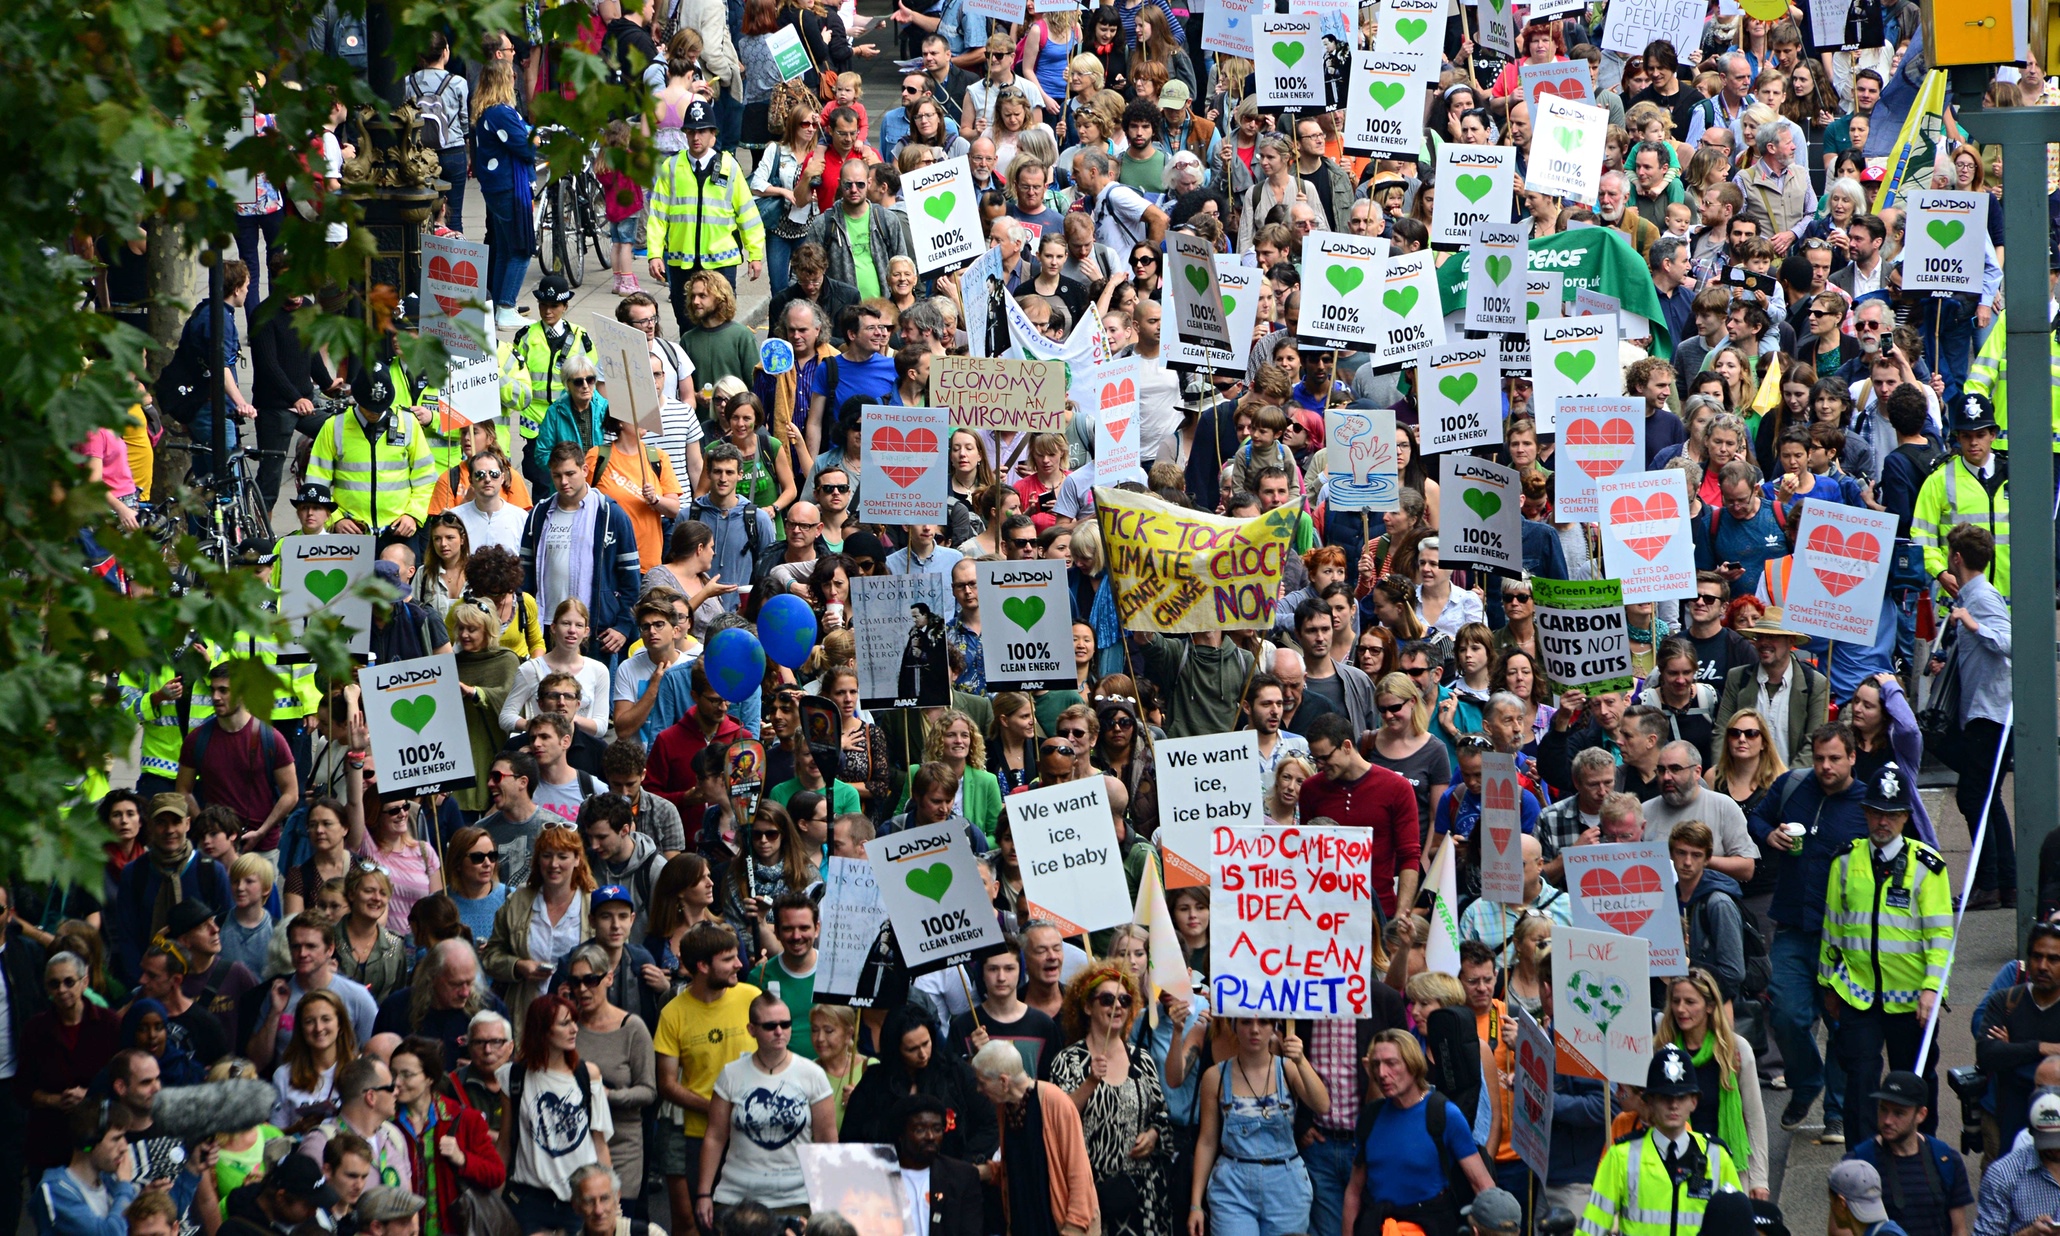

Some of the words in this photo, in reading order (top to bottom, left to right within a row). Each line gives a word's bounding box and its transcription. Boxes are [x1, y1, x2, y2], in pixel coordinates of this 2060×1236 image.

[1264, 21, 1310, 33] LONDON
[1624, 6, 1681, 32] PEEVED.
[1489, 20, 1507, 38] 100%
[1612, 23, 1657, 49] GET
[1363, 58, 1416, 72] LONDON
[1274, 76, 1307, 90] 100%
[1268, 91, 1289, 99] CLEAN
[1290, 91, 1314, 100] ENERGY
[1366, 118, 1402, 135] 100%
[1357, 134, 1379, 143] CLEAN
[1380, 135, 1408, 146] ENERGY
[1450, 150, 1503, 164] LONDON
[1548, 159, 1582, 178] 100%
[912, 167, 959, 190] LONDON
[1920, 198, 1976, 210] LONDON
[930, 227, 965, 251] 100%
[1445, 228, 1467, 236] CLEAN
[1480, 230, 1520, 244] LONDON
[450, 245, 468, 255] LOVE
[927, 249, 947, 263] CLEAN
[948, 242, 973, 256] ENERGY
[1176, 240, 1210, 257] LONDON
[1321, 240, 1376, 256] LONDON
[1925, 258, 1963, 274] 100%
[1916, 274, 1939, 283] CLEAN
[1941, 275, 1970, 284] ENERGY
[1190, 303, 1217, 322] 100%
[1322, 304, 1359, 323] 100%
[1483, 297, 1510, 313] 100%
[1187, 319, 1205, 331] CLEAN
[1205, 322, 1222, 334] ENERGY
[1312, 320, 1335, 332] CLEAN
[1336, 322, 1366, 334] ENERGY
[1476, 314, 1494, 323] CLEAN
[1495, 315, 1516, 325] ENERGY
[421, 325, 457, 340] SOMETHING
[1388, 324, 1425, 345] 100%
[1544, 325, 1603, 342] LONDON
[1182, 347, 1206, 357] CLEAN
[1207, 350, 1235, 362] ENERGY
[1383, 344, 1406, 357] CLEAN
[1407, 339, 1434, 353] ENERGY
[1429, 348, 1487, 368] LONDON
[1020, 362, 1048, 379] NO
[440, 384, 455, 396] but
[470, 373, 487, 388] like
[488, 371, 498, 381] to
[940, 370, 1045, 396] ECONOMY
[935, 389, 1013, 407] WITHOUT
[1025, 396, 1047, 410] AN
[1560, 405, 1576, 413] FOR
[1579, 405, 1595, 413] THE
[1597, 405, 1618, 413] LOVE
[866, 413, 882, 421] FOR
[902, 415, 923, 423] LOVE
[940, 406, 1065, 430] NVIRONMENT
[1440, 412, 1480, 432] 100%
[1433, 433, 1458, 445] CLEAN
[1459, 428, 1488, 442] ENERGY
[1454, 464, 1510, 486] LONDON
[1601, 483, 1618, 492] FOR
[1620, 481, 1636, 490] THE
[1638, 480, 1659, 489] LOVE
[864, 500, 912, 508] SOMETHING
[914, 501, 943, 509] ABOUT
[885, 492, 907, 500] LET'S
[908, 492, 922, 500] DO
[867, 508, 902, 516] CLIMATE
[904, 509, 939, 517] CHANGE
[1807, 507, 1825, 518] FOR
[1827, 511, 1844, 522] THE
[1846, 514, 1869, 526] LOVE
[1629, 521, 1656, 536] LIFE
[1463, 527, 1502, 549] 100%
[297, 545, 360, 559] LONDON
[1454, 544, 1480, 555] CLEAN
[1481, 547, 1510, 561] ENERGY
[1108, 544, 1193, 582] LIMATE
[1633, 567, 1654, 576] LET'S
[1655, 565, 1669, 573] DO
[868, 578, 925, 590] WINTER
[991, 571, 1053, 586] LONDON
[1663, 571, 1691, 581] ABOUT
[858, 592, 869, 601] IS
[872, 589, 937, 601] COMING
[1553, 585, 1586, 596] Green
[1589, 584, 1619, 597] Party
[1653, 581, 1689, 592] CHANGE
[1154, 574, 1208, 627] CHANGE
[1838, 603, 1852, 613] DO
[1539, 612, 1622, 633] CARBON
[1788, 603, 1841, 621] SOMETHING
[1843, 614, 1874, 627] ABOUT
[1790, 613, 1828, 628] CLIMATE
[1830, 621, 1868, 636] CHANGE
[1007, 642, 1051, 661] 100%
[1543, 636, 1582, 656] CUTS
[1587, 634, 1624, 655] NOT
[862, 650, 901, 659] ENERGY
[1000, 661, 1027, 672] CLEAN
[1028, 661, 1060, 672] ENERGY
[1548, 659, 1577, 678] JOB
[1582, 655, 1627, 677] CUTS
[376, 666, 442, 690] LONDON
[398, 741, 445, 767] 100%
[1167, 750, 1198, 768] We
[1203, 744, 1249, 764] want
[393, 767, 420, 781] CLEAN
[422, 760, 456, 776] ENERGY
[1194, 777, 1227, 793] ice,
[1018, 803, 1049, 822] We
[1054, 790, 1099, 814] want
[1173, 805, 1199, 822] ice
[1206, 801, 1252, 820] baby
[1048, 827, 1081, 844] ice,
[885, 832, 952, 862] LONDON
[1213, 826, 1276, 859] DAVID
[1278, 828, 1373, 872] CAMERON
[1031, 857, 1059, 876] ice
[1063, 847, 1107, 869] baby
[1568, 854, 1588, 864] FOR
[1590, 853, 1610, 862] THE
[1612, 851, 1638, 861] LOVE
[1221, 864, 1245, 891] IS
[1248, 863, 1297, 891] THIS
[1306, 866, 1371, 901] YOUR
[1503, 883, 1520, 892] CHANGE
[1591, 895, 1649, 912] Health
[1237, 892, 1312, 922] IDEA
[1316, 913, 1350, 935] OF
[921, 909, 971, 938] 100%
[919, 936, 949, 953] CLEAN
[949, 927, 984, 945] ENERGY
[1229, 931, 1257, 958] A
[1259, 937, 1364, 977] CLEAN
[1569, 938, 1619, 962] LOVE
[1213, 974, 1368, 1014] PLANET?
[1556, 1038, 1570, 1054] 38
